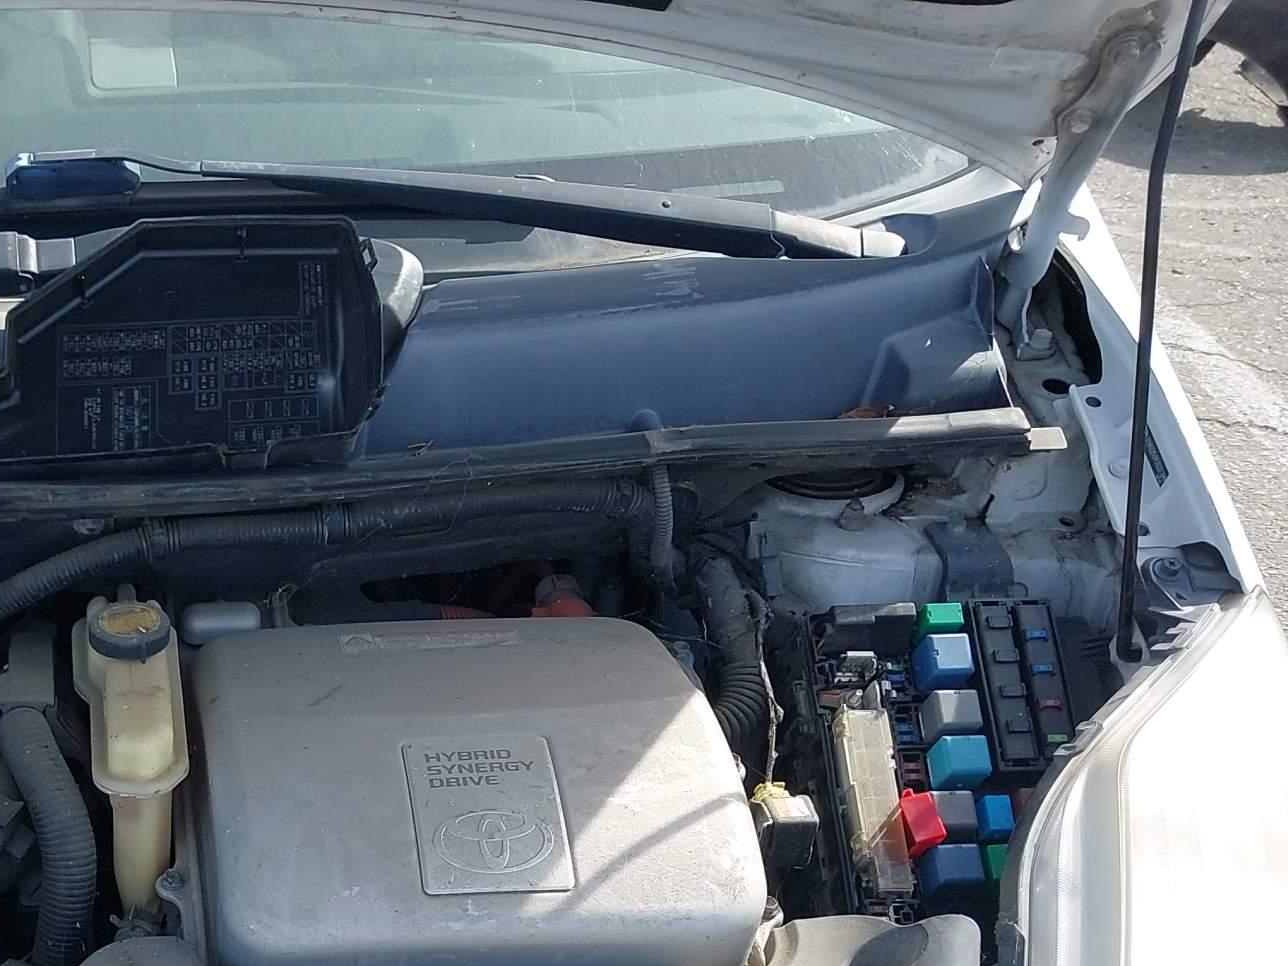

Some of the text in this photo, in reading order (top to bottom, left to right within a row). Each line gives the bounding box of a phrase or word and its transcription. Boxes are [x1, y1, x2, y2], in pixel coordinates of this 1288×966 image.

[424, 749, 512, 763] HYBRID
[426, 761, 534, 776] SYNERGY
[429, 775, 500, 789] DRIVE
